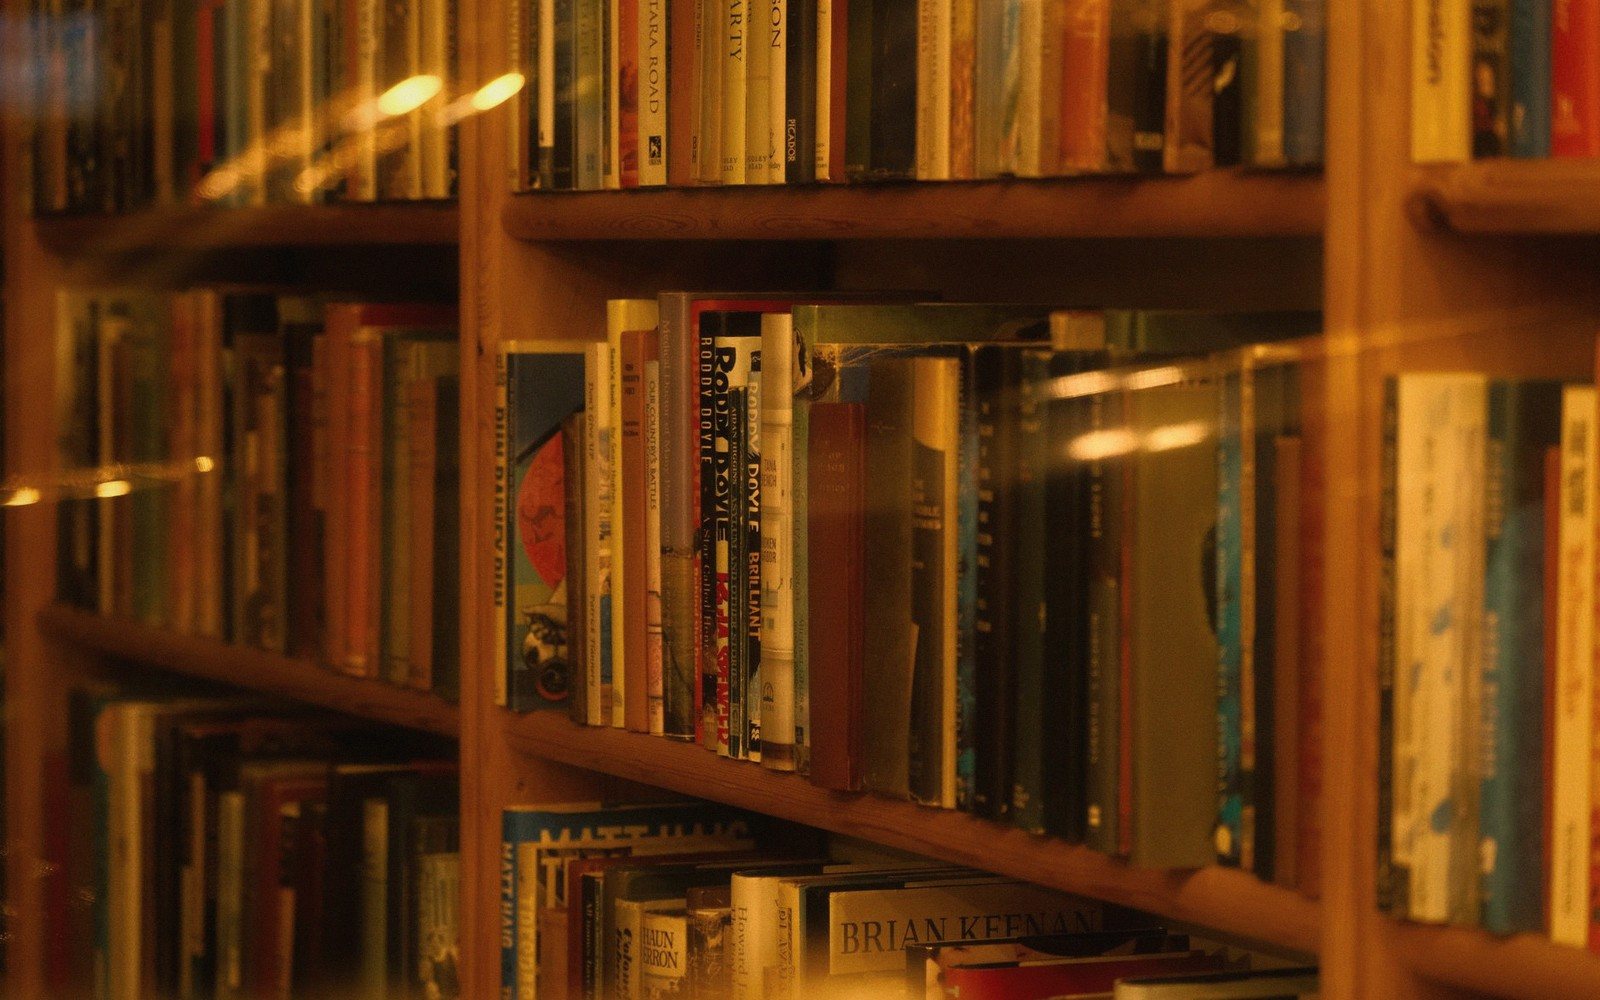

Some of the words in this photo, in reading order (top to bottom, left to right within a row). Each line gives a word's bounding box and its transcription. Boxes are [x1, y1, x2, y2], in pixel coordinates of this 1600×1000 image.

[648, 0, 659, 49] TARA
[647, 56, 659, 115] ROAD
[787, 117, 796, 162] PICADOR
[700, 335, 712, 397] RODDY
[700, 407, 712, 465] DOYLE
[730, 406, 739, 439] AIDAN
[747, 380, 761, 453] RODDY
[731, 440, 739, 486] HIGGINS
[748, 462, 761, 534] DOYLE
[748, 551, 762, 642] BRILLIANT
[642, 927, 675, 950] HAUN
[642, 946, 679, 970] ERRON
[737, 906, 748, 975] Howard
[840, 917, 952, 955] BRIAN
